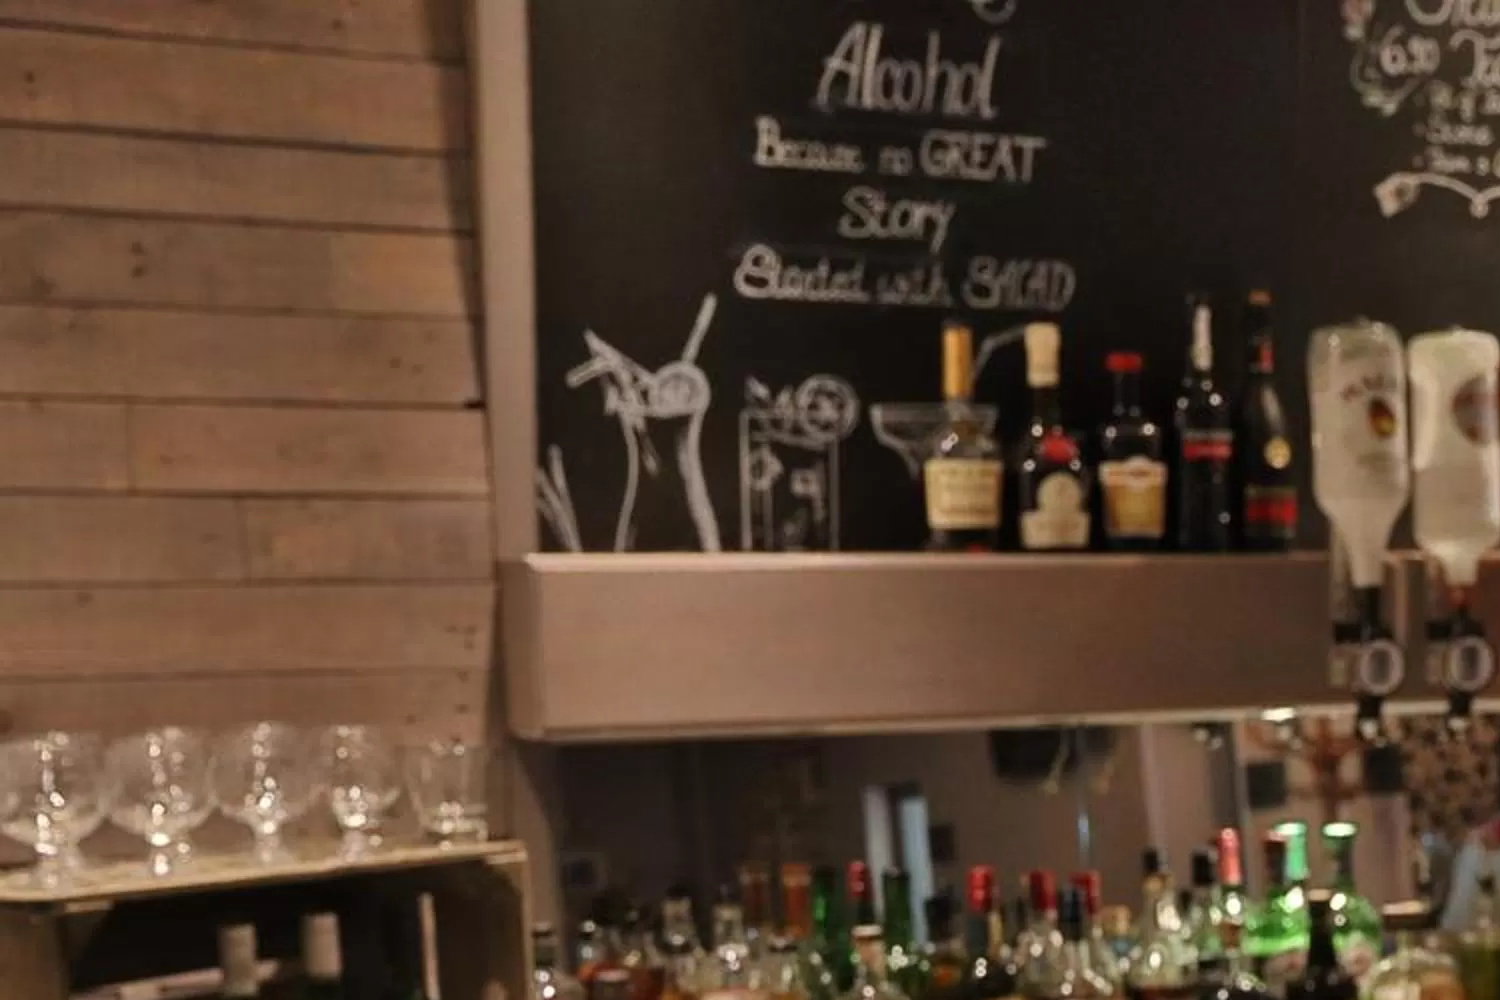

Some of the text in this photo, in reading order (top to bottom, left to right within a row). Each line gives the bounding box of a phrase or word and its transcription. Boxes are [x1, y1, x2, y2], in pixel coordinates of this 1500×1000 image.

[812, 22, 1001, 120] Alcohol
[919, 128, 1048, 183] GREAT
[838, 185, 957, 256] Story
